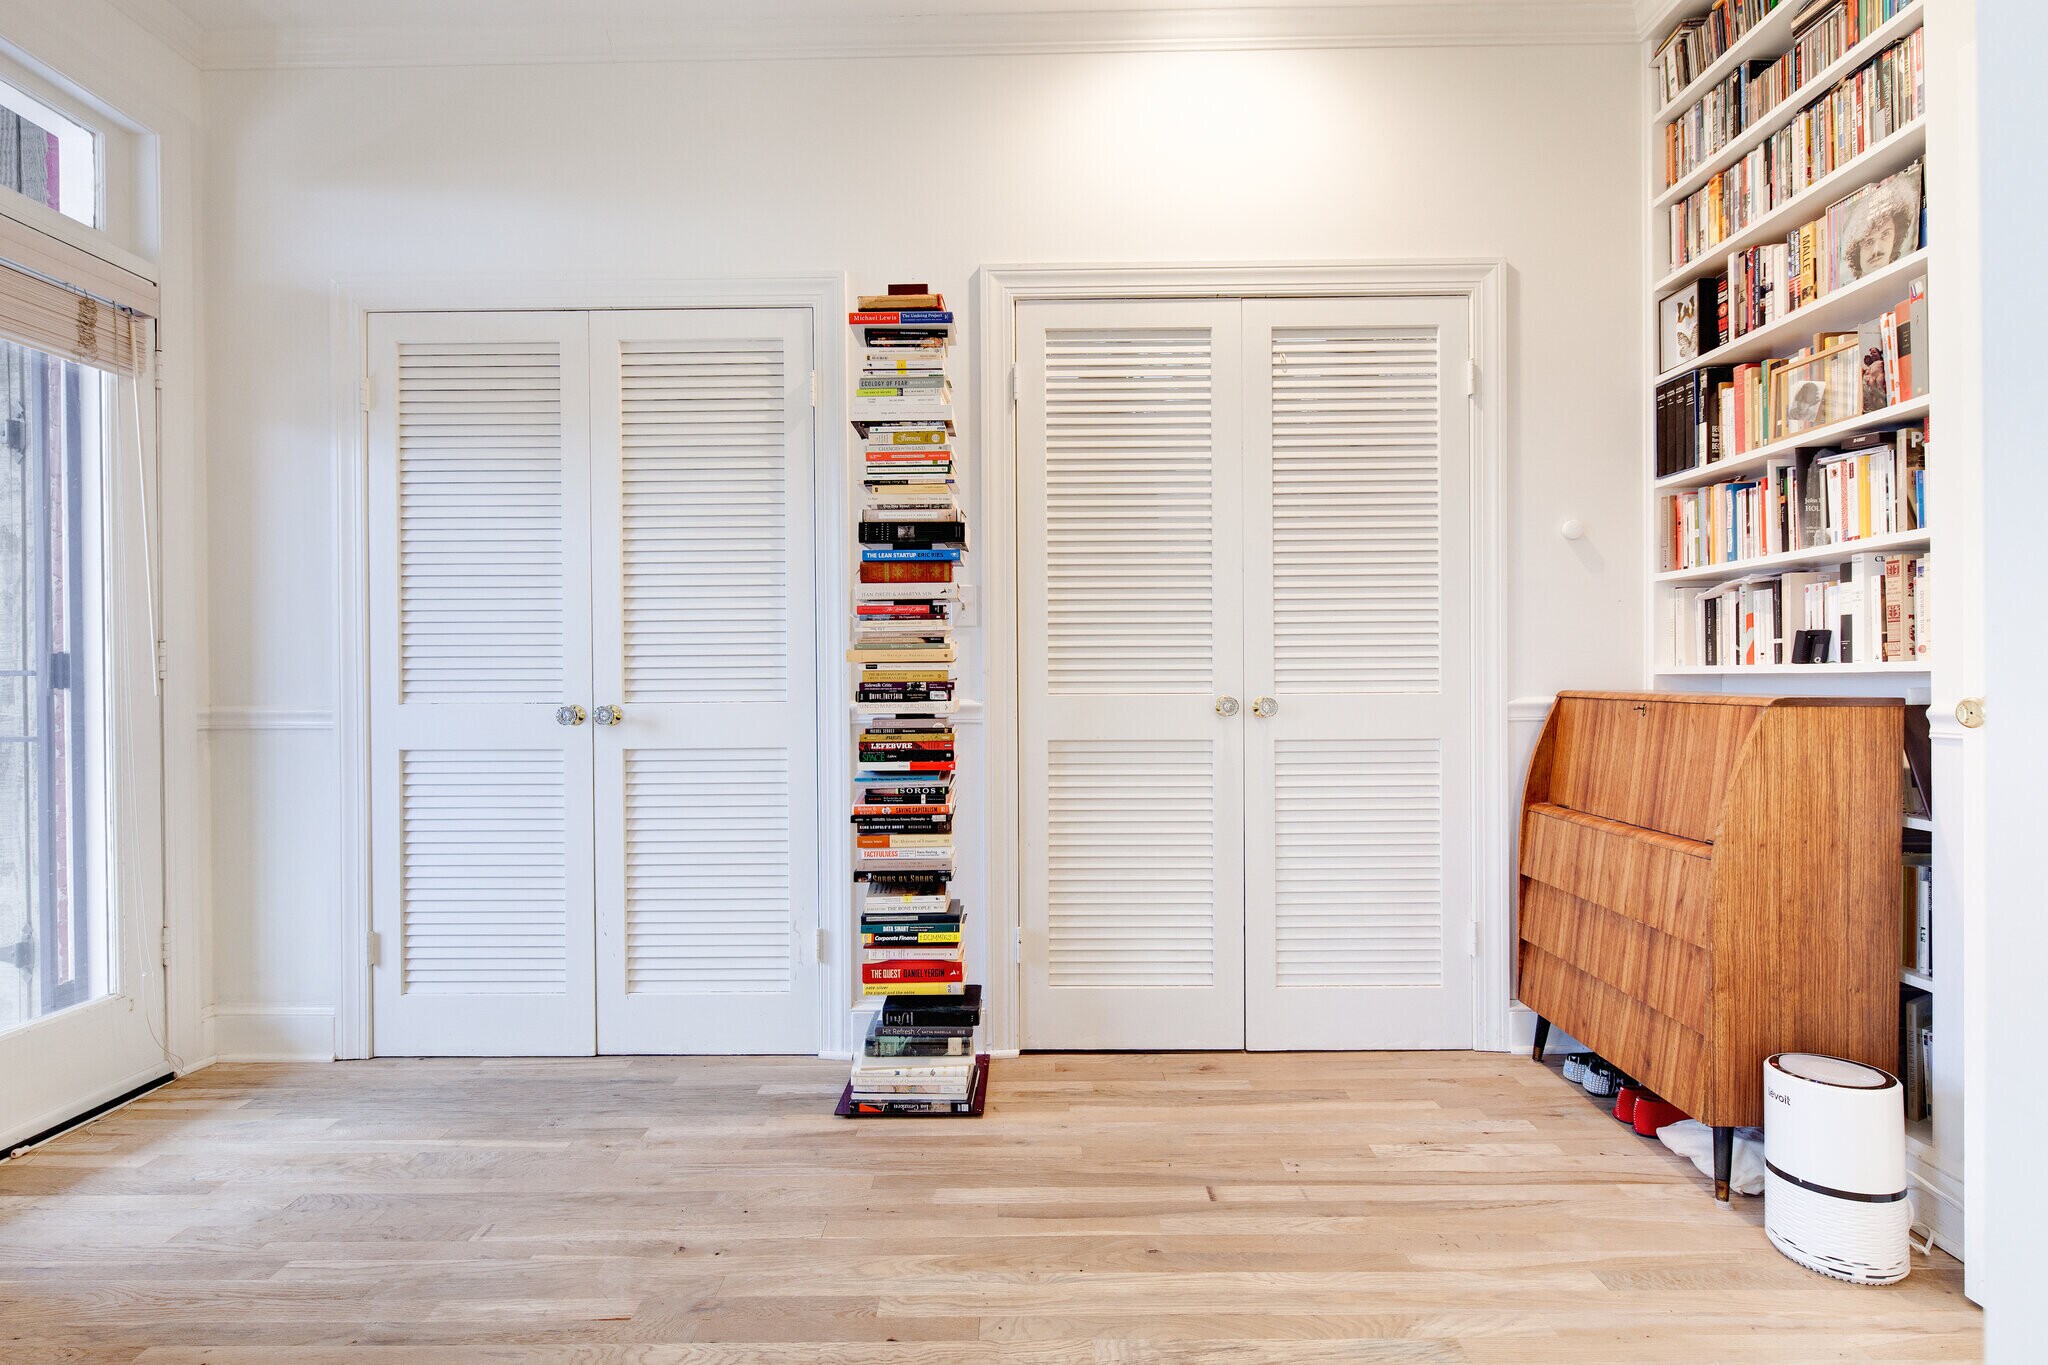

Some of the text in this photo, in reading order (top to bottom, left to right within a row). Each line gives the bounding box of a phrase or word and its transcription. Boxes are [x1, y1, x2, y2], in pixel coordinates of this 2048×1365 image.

[1802, 235, 1811, 272] MALLE
[872, 875, 896, 883] SOROS
[910, 874, 934, 882] SOROS
[871, 968, 945, 978] THE QUEST DANIEL YERGIN
[1768, 1087, 1791, 1106] levoit
